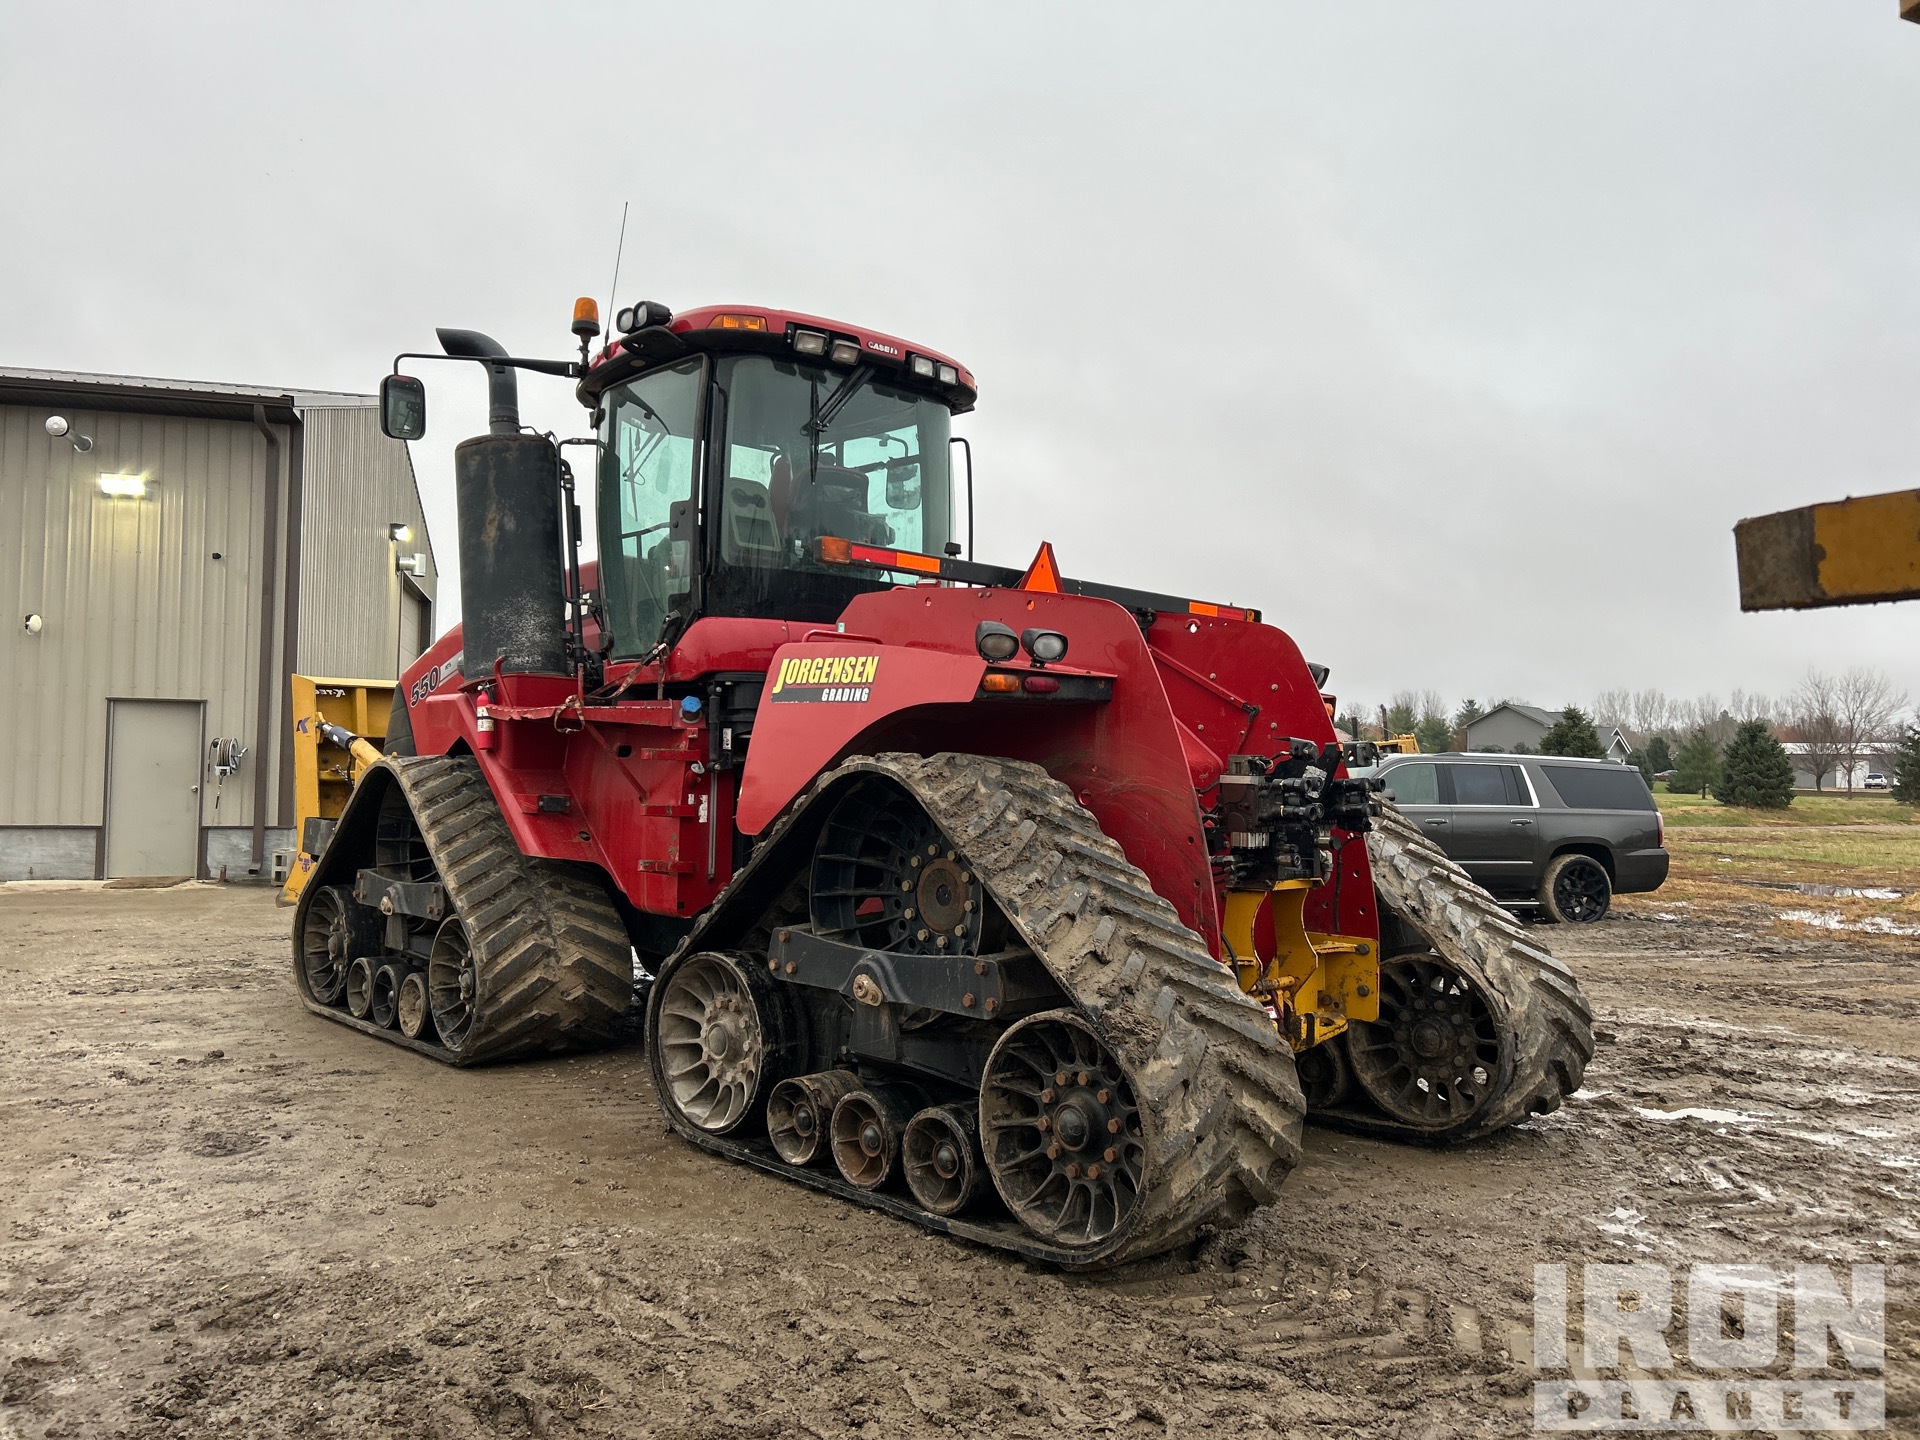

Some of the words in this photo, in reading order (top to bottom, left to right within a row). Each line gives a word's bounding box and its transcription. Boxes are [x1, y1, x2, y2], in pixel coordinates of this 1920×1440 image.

[410, 665, 440, 708] 550
[772, 656, 879, 694] JORGENSEN
[821, 688, 870, 702] GRADING
